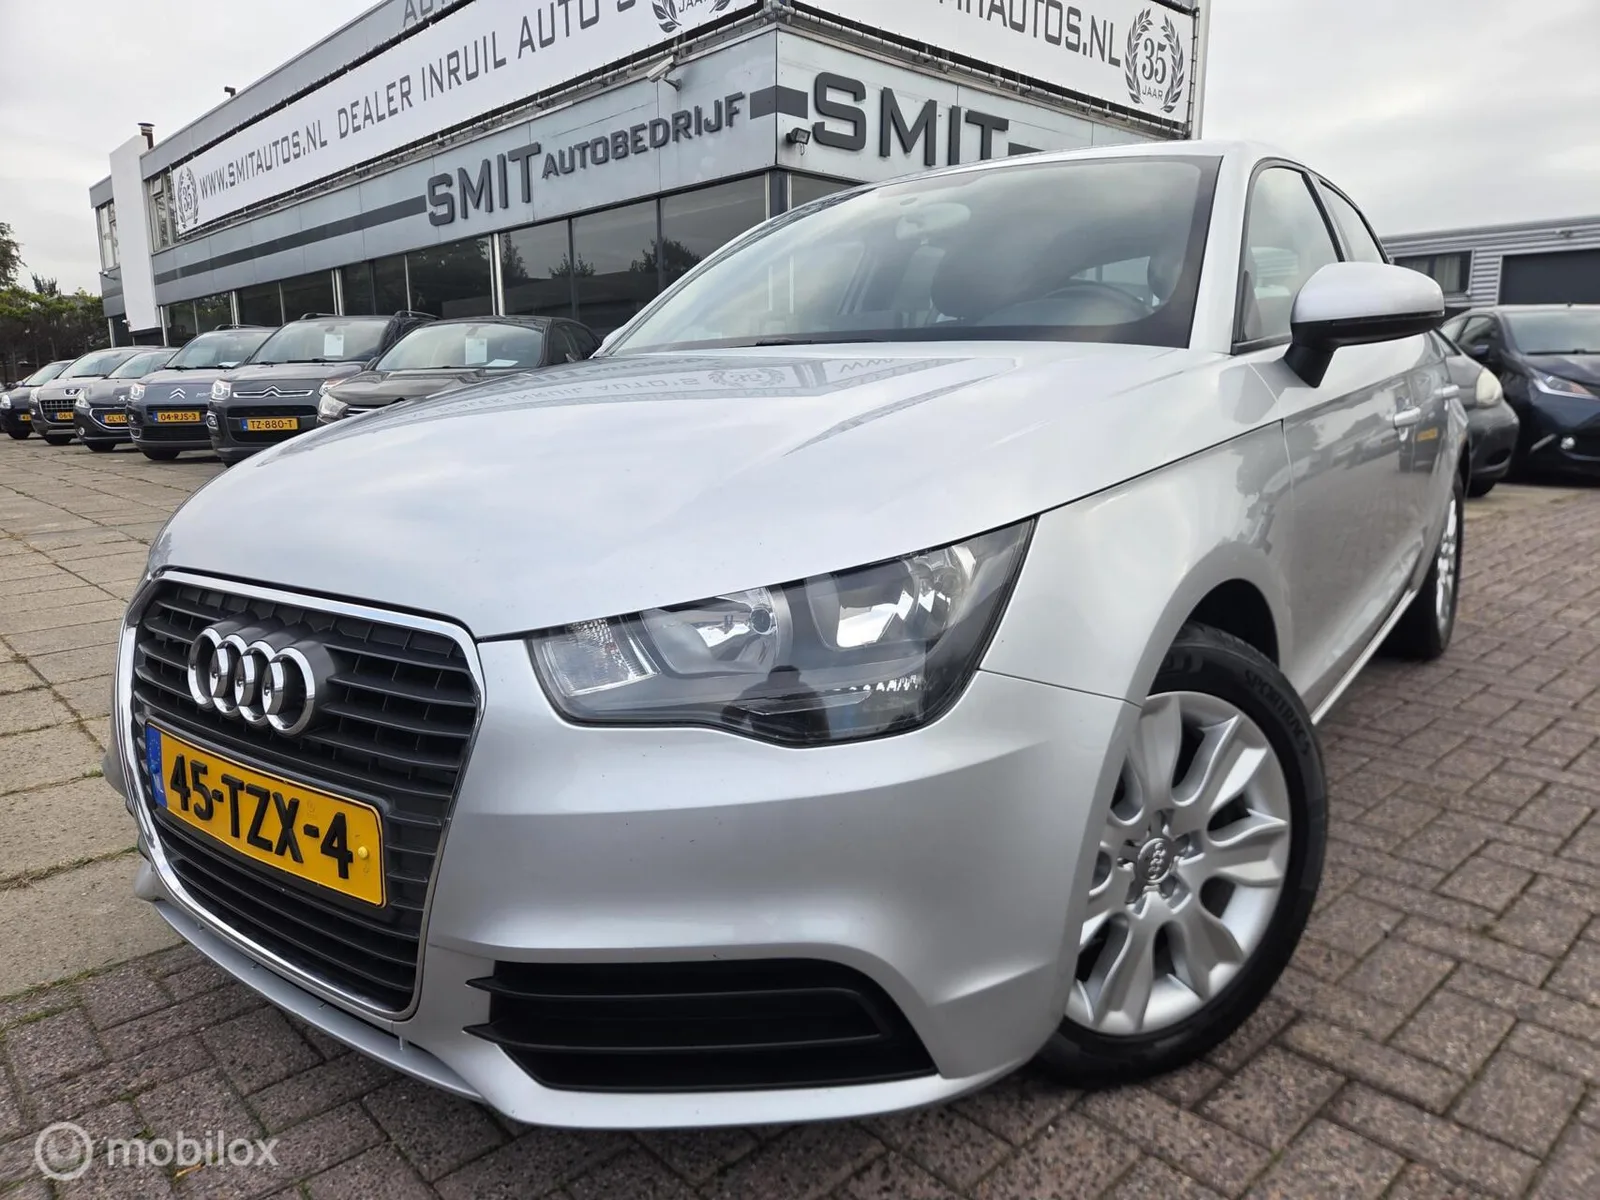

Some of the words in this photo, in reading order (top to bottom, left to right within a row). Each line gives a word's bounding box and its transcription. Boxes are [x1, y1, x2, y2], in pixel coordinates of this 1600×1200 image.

[1141, 37, 1167, 84] 35
[1142, 85, 1164, 101] JAAR
[199, 119, 328, 200] WWW.SMITAUTOS.NL
[337, 75, 413, 139] DEALER
[421, 31, 507, 102] INRUIL
[812, 71, 1009, 166] SMIT
[427, 142, 541, 227] SMIT
[541, 92, 746, 180] AUTOBEDRIJF
[160, 413, 197, 421] 04-RJS-3
[250, 419, 293, 429] TZ-880-T
[169, 752, 354, 879] 45-TZX-4
